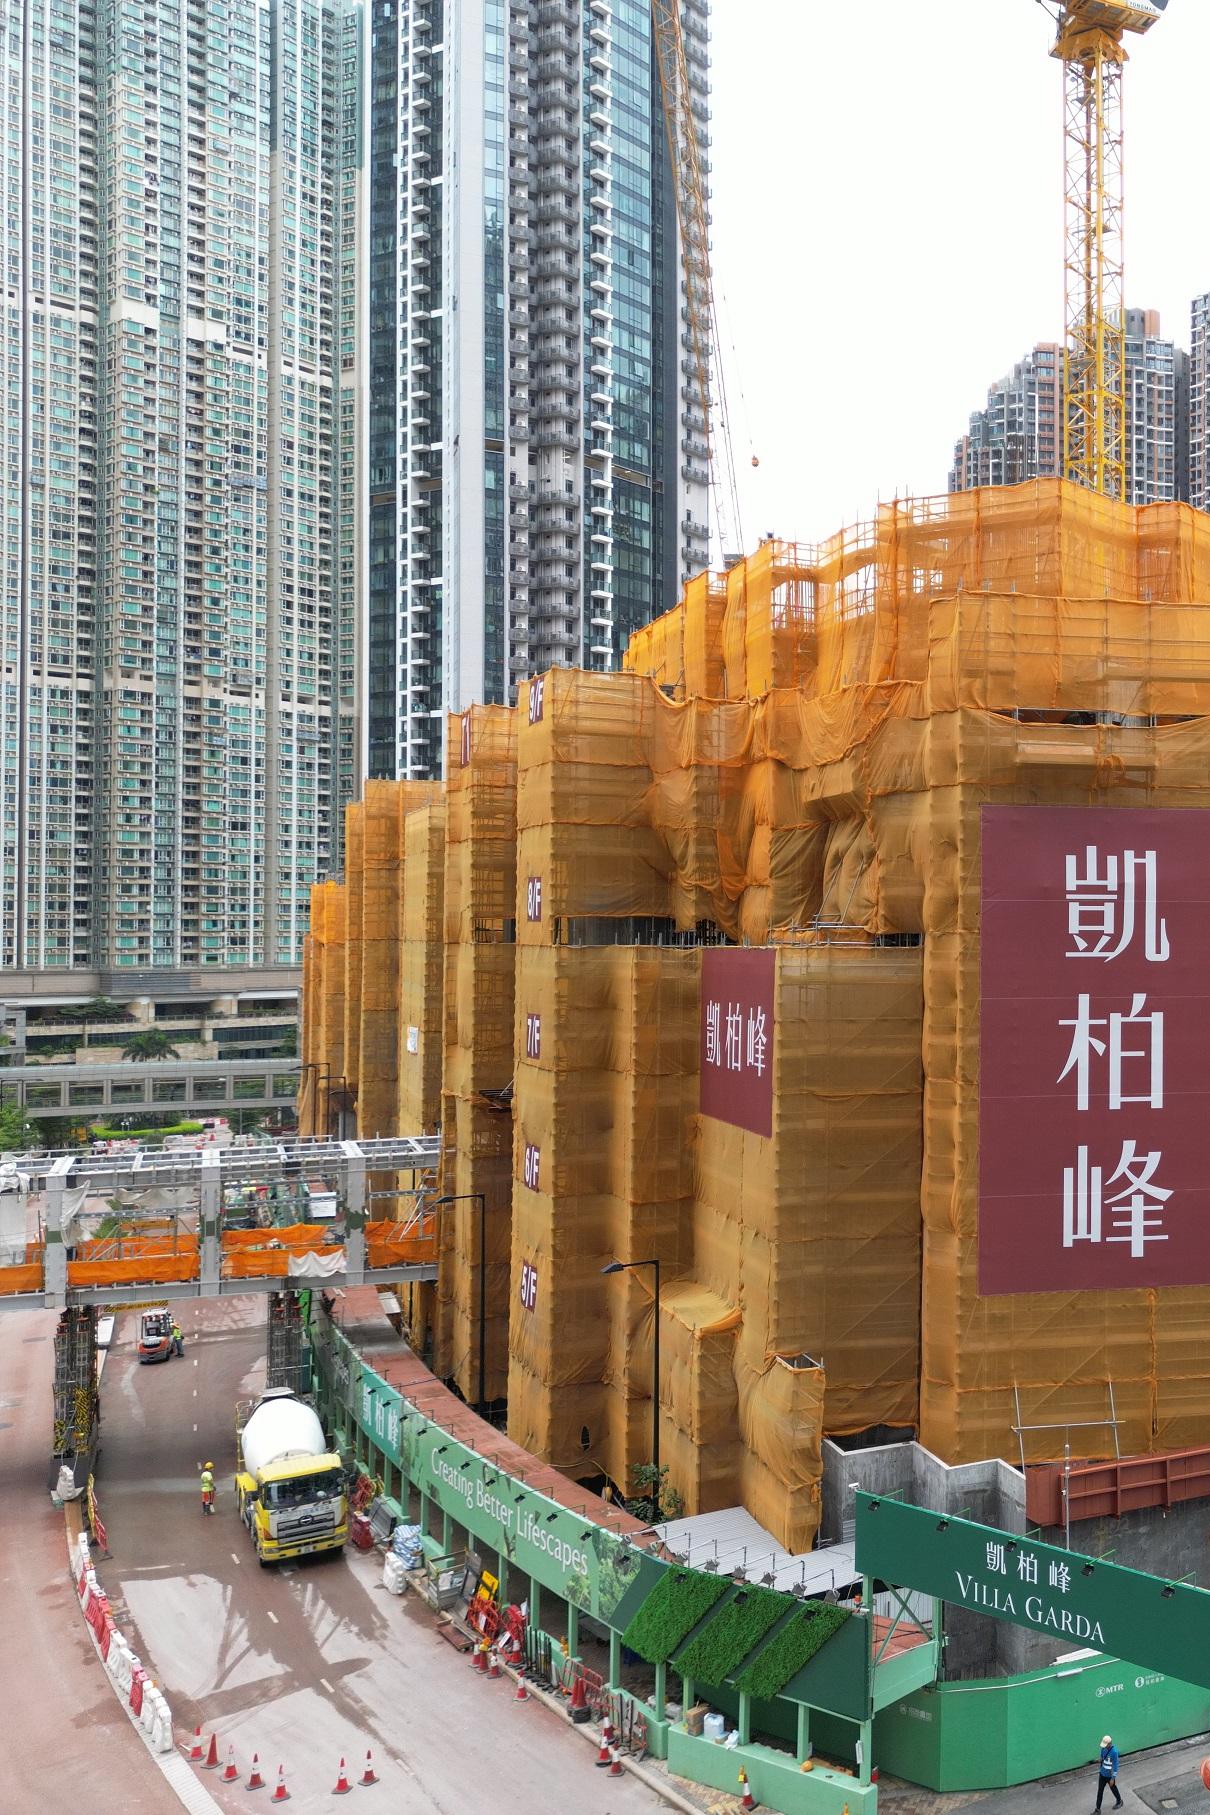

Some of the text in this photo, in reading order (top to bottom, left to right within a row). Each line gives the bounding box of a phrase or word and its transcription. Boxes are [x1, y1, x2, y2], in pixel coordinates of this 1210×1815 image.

[529, 679, 544, 723] 9/F
[527, 879, 541, 920] 8/F
[527, 1015, 540, 1057] 7/F
[706, 999, 767, 1077] 凱柏峰
[1056, 845, 1175, 1258] 凱柏峰
[524, 1146, 540, 1188] 6/F
[521, 1265, 537, 1307] 5/F
[431, 1447, 588, 1576] Creating Better Lifescapes
[986, 1541, 1072, 1594] 凱柏峰
[955, 1570, 1105, 1645] VILLA GARDA
[1105, 1683, 1124, 1694] MTR
